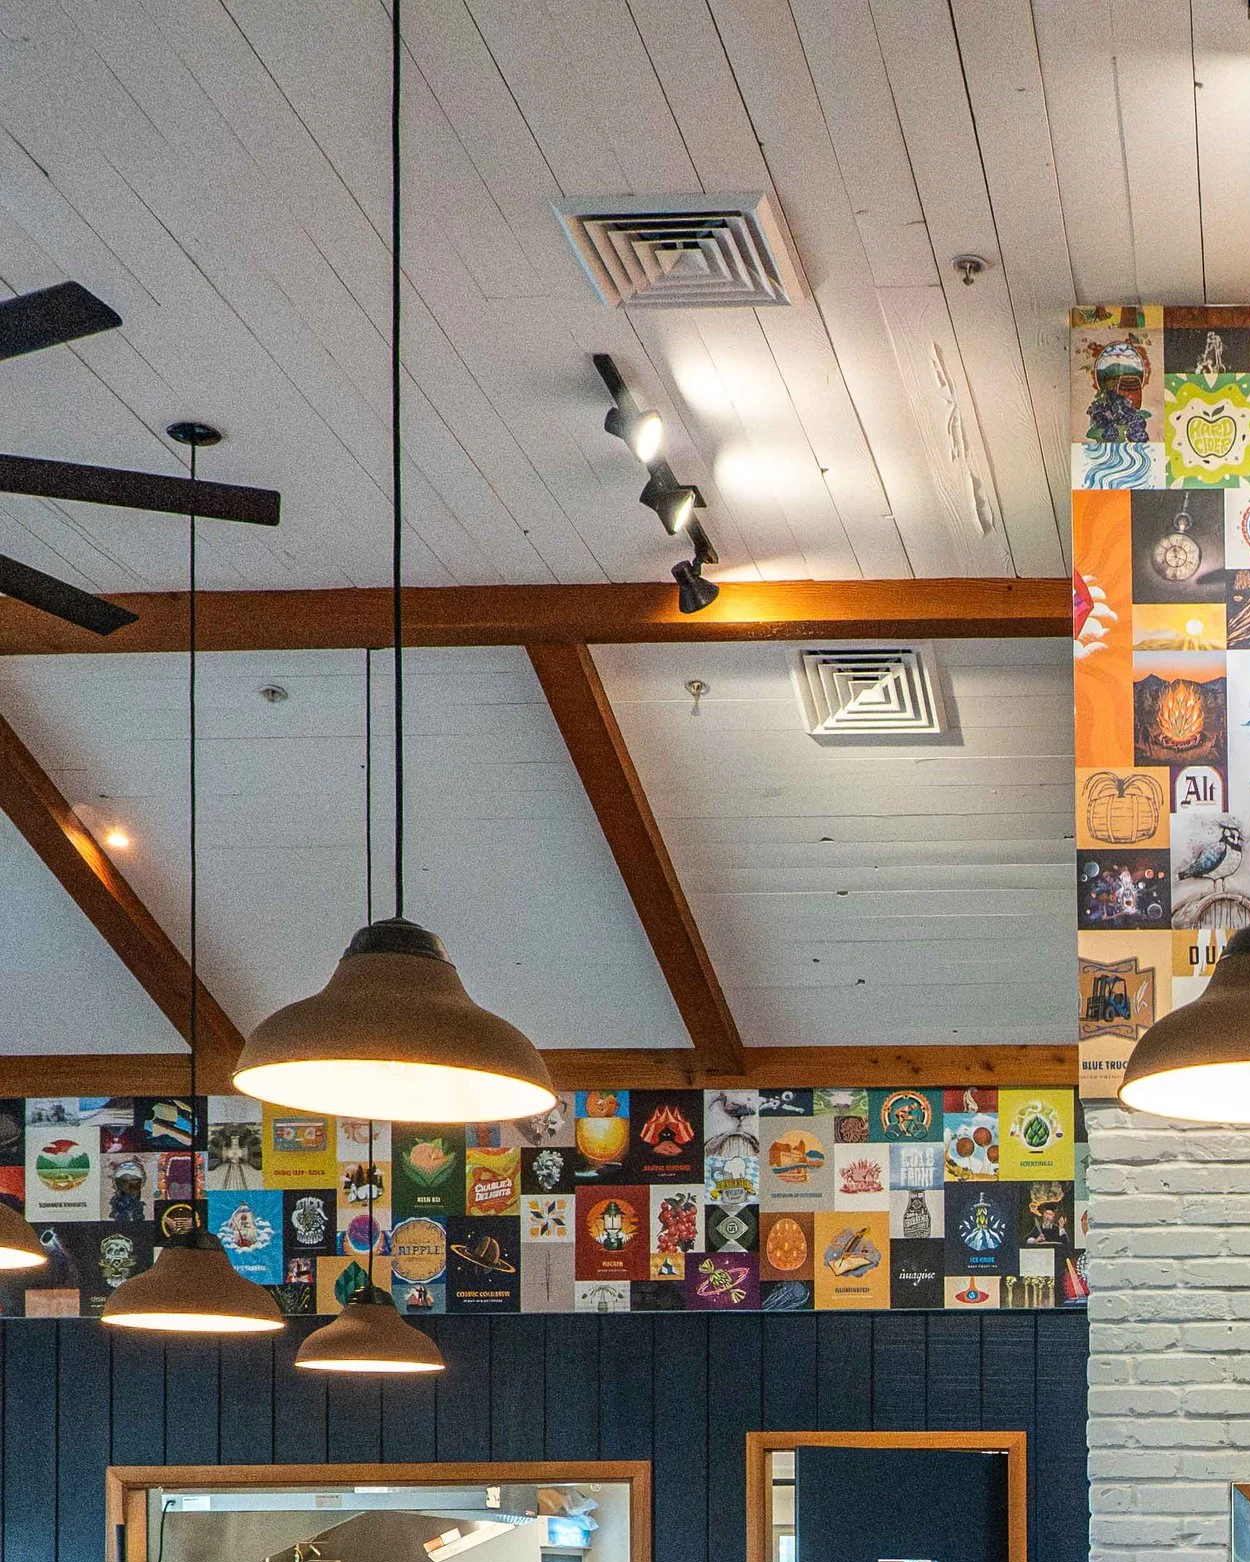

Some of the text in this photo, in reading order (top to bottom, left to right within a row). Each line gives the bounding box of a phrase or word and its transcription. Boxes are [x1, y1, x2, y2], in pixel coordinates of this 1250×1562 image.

[1190, 419, 1234, 438] HARD
[1195, 438, 1229, 454] CIDER
[1181, 776, 1217, 807] Alt
[1082, 1061, 1128, 1070] BLUE TRUC
[899, 1268, 936, 1286] imagine
